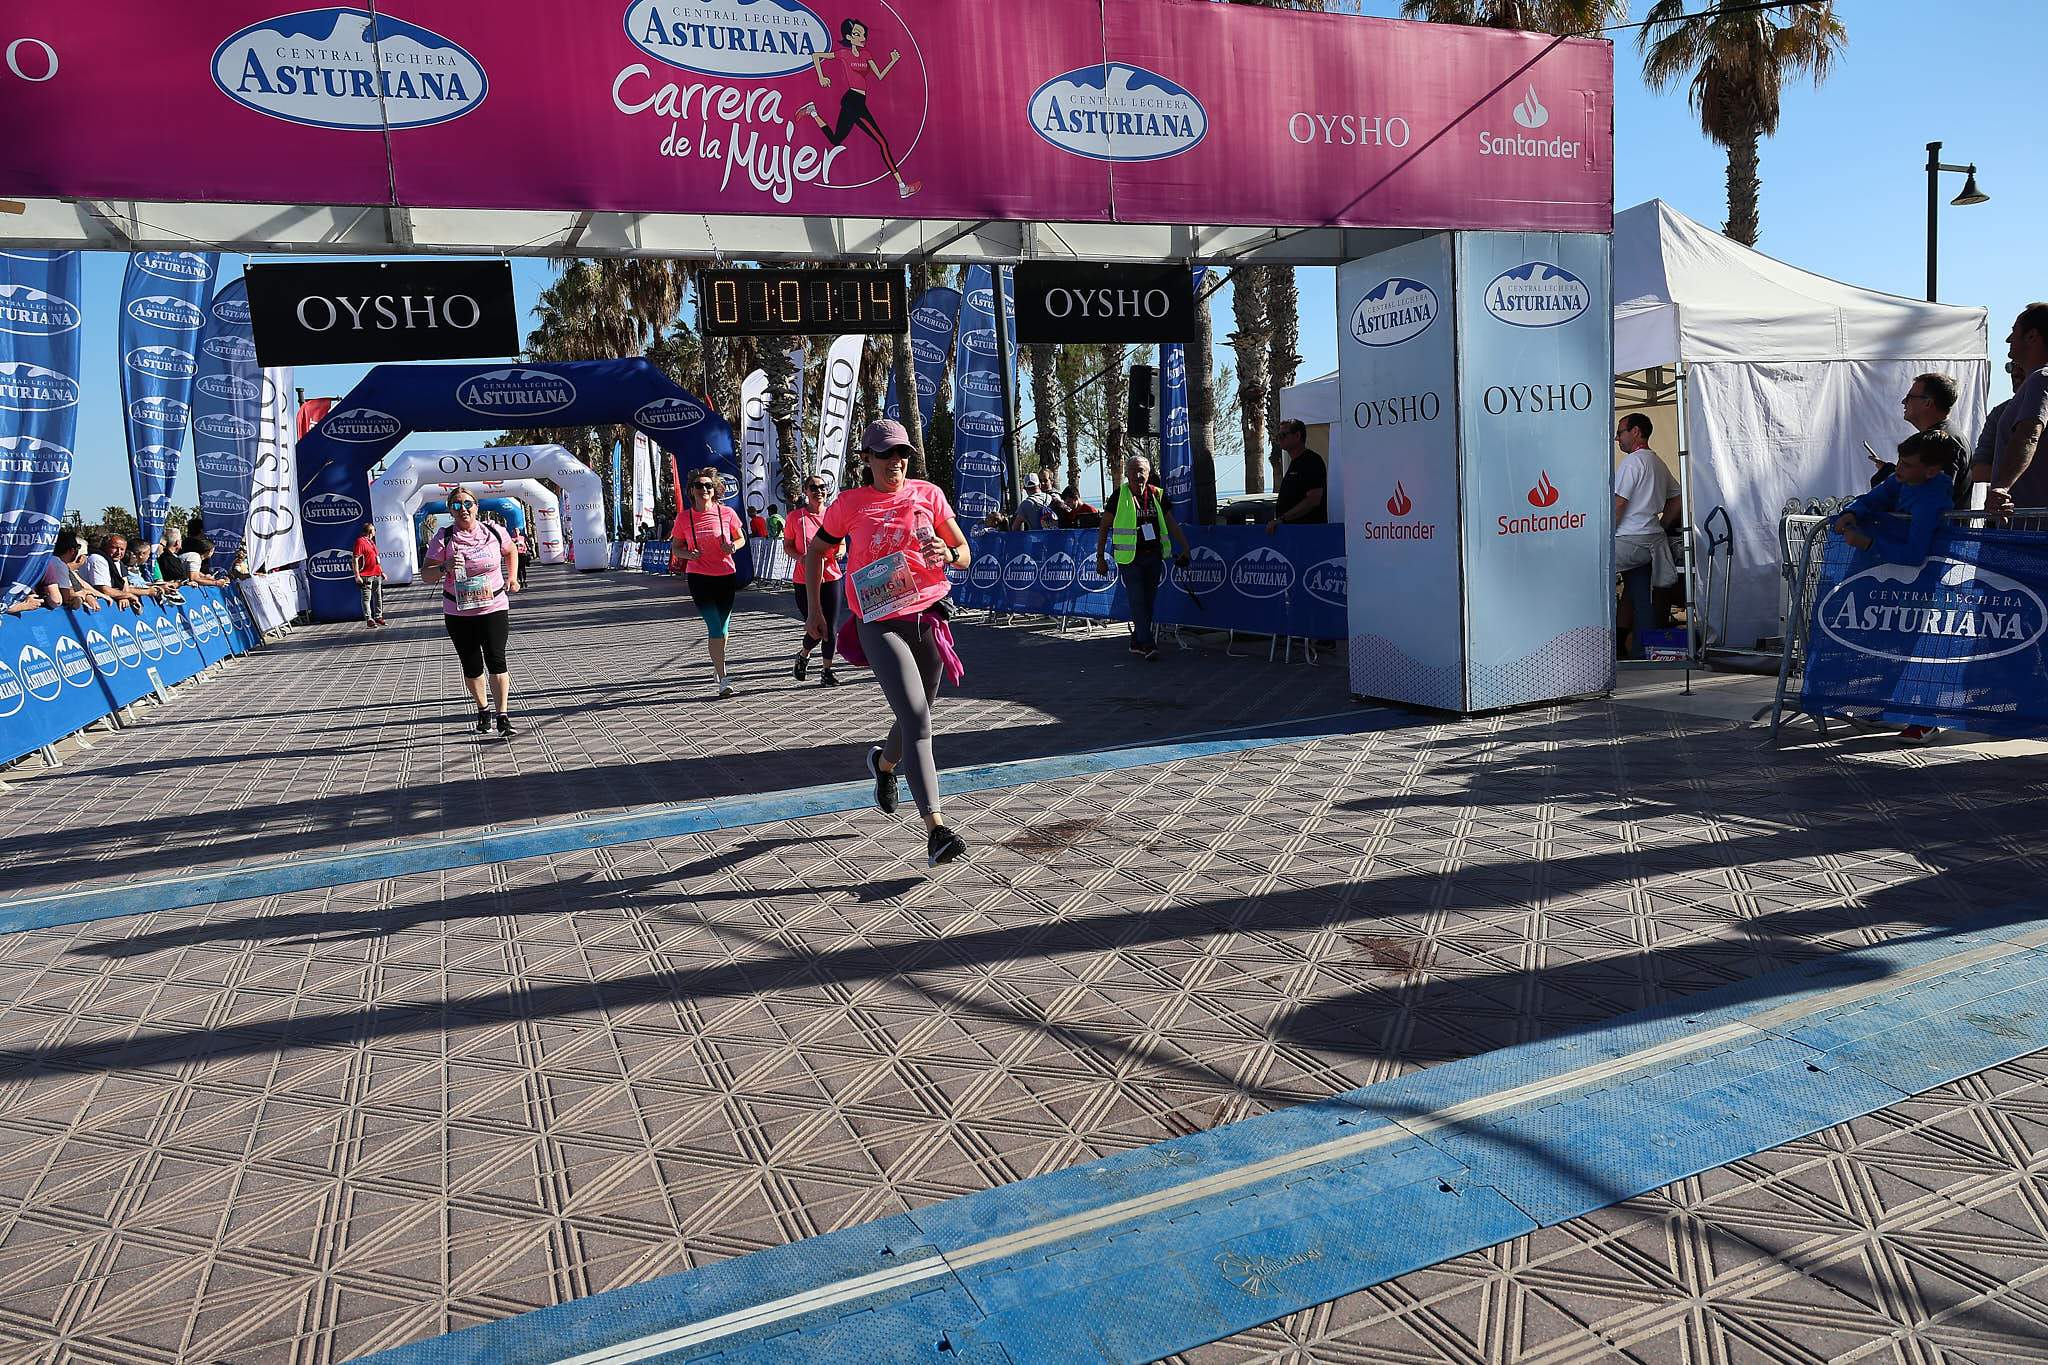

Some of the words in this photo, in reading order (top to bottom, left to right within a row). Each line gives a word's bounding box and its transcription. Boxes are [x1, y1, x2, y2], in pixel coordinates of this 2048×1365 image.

[672, 7, 738, 20] CENTRAL
[744, 13, 808, 26] LECHERA
[643, 7, 816, 56] ASTURIANA
[276, 48, 364, 62] CENTRAL
[372, 52, 456, 66] LECHERA
[236, 48, 470, 100] ASTURIANA
[612, 64, 784, 124] Carrera
[1070, 95, 1126, 106] CENTRAL
[1132, 100, 1188, 110] LECHERA
[1044, 96, 1195, 138] ASTURIANA
[1289, 112, 1410, 148] OYSHO
[1479, 131, 1581, 160] Santander
[660, 122, 692, 156] de
[700, 122, 722, 158] la
[720, 120, 847, 204] Mujer
[143, 256, 206, 278] ASTURIANA
[1492, 286, 1582, 312] ASTURIANA
[1508, 284, 1542, 292] CENTRAL
[1544, 284, 1579, 292] LECHERA
[296, 294, 480, 332] OYSHO
[1045, 288, 1170, 318] OYSHO
[1367, 302, 1396, 314] CENTRAL
[1397, 294, 1428, 308] LECHERA
[134, 304, 200, 326] ASTURIANA
[1356, 304, 1432, 336] ASTURIANA
[201, 380, 254, 396] ASTURIANA
[467, 384, 568, 404] ASTURIANA
[1484, 382, 1592, 414] OYSHO
[642, 412, 700, 424] ASTURIANA
[1354, 392, 1440, 429] OYSHO
[199, 420, 252, 436] ASTURIANA
[326, 422, 395, 434] ASTURIANA
[820, 358, 854, 497] OYSHO
[198, 458, 248, 473] ASTURIANA
[438, 452, 532, 474] OYSHO
[746, 397, 765, 513] OYSHO
[383, 478, 412, 486] OYSHO
[305, 506, 360, 518] ASTURIANA
[374, 514, 402, 523] OYSHO
[1365, 520, 1434, 540] Santander
[1498, 511, 1586, 536] Santander
[1174, 567, 1222, 583] ASTURIANA
[1234, 566, 1288, 586] ASTURIANA
[1870, 590, 1938, 602] CENTRAL
[1945, 593, 2022, 607] LECHERA
[1830, 591, 2025, 640] ASTURIANA
